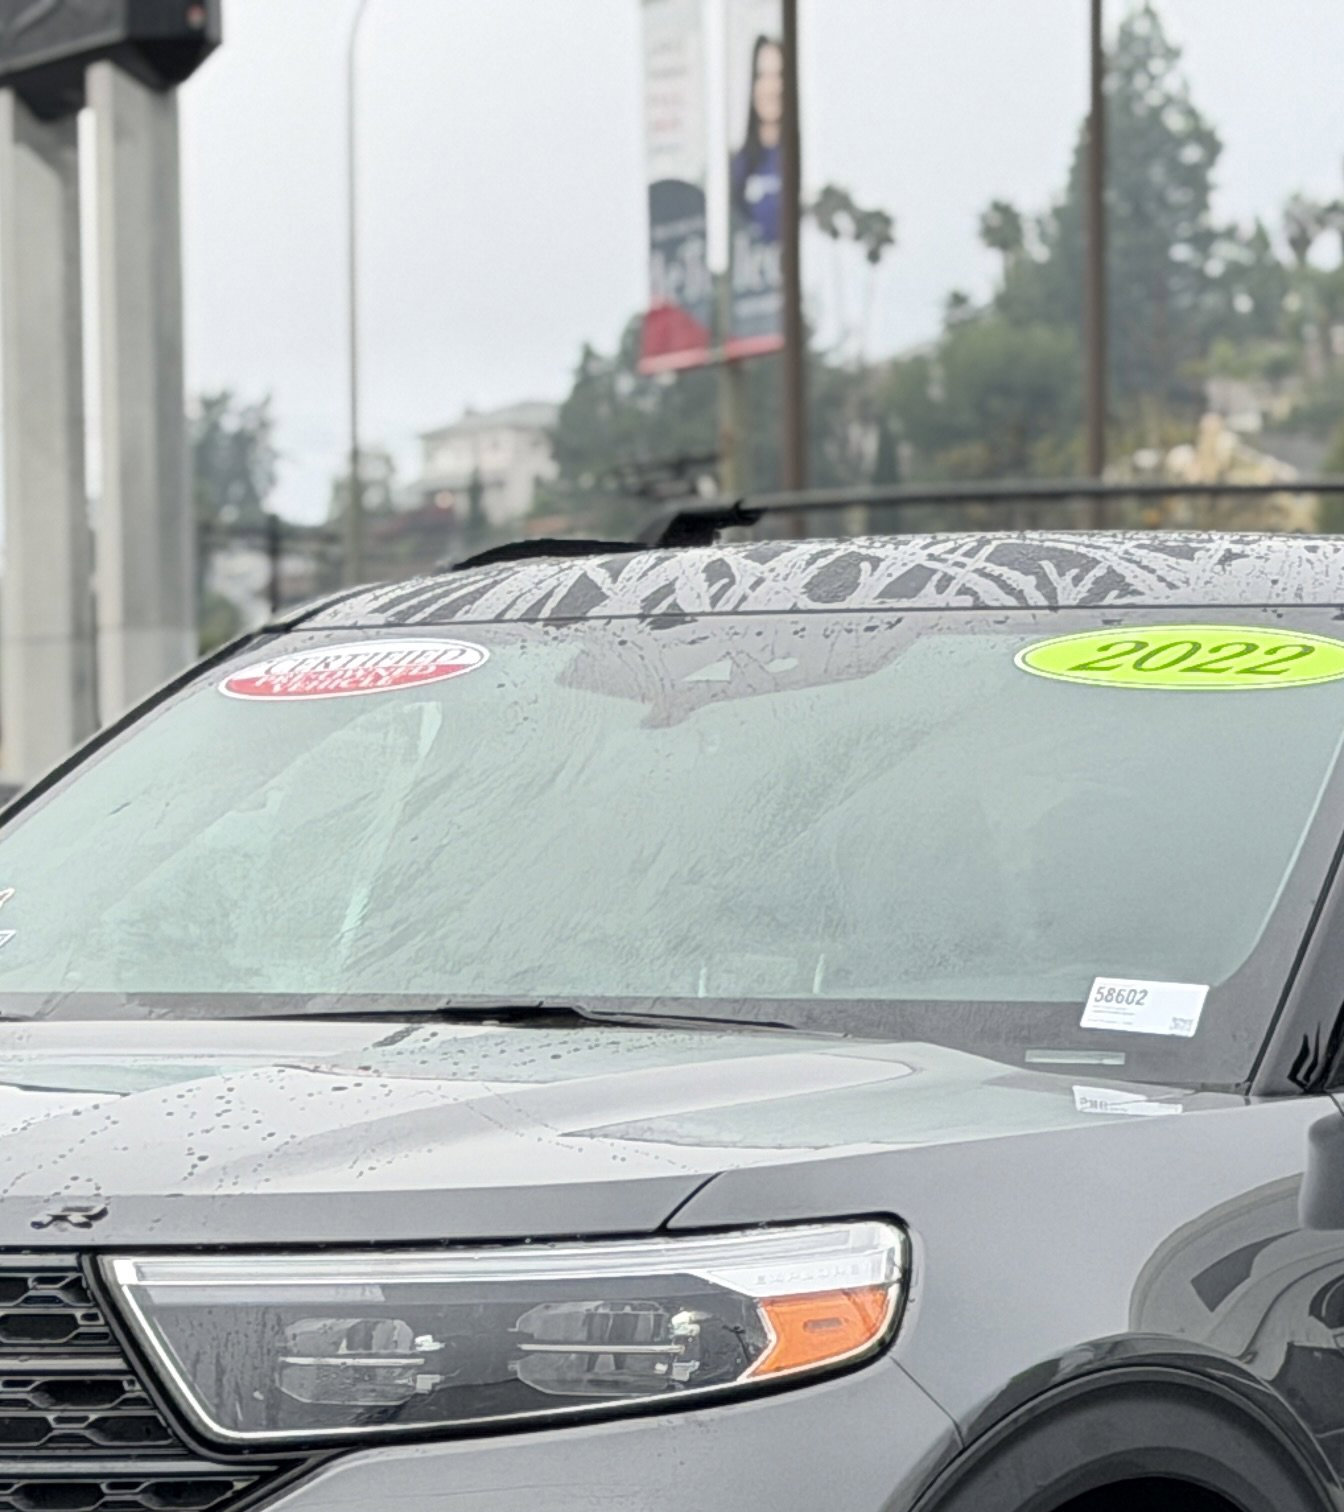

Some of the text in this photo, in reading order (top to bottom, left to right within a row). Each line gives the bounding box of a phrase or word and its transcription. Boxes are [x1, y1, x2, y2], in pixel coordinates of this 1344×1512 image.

[264, 648, 468, 676] CERTIFIED
[1066, 639, 1316, 676] 2022
[1093, 986, 1149, 1006] 58602
